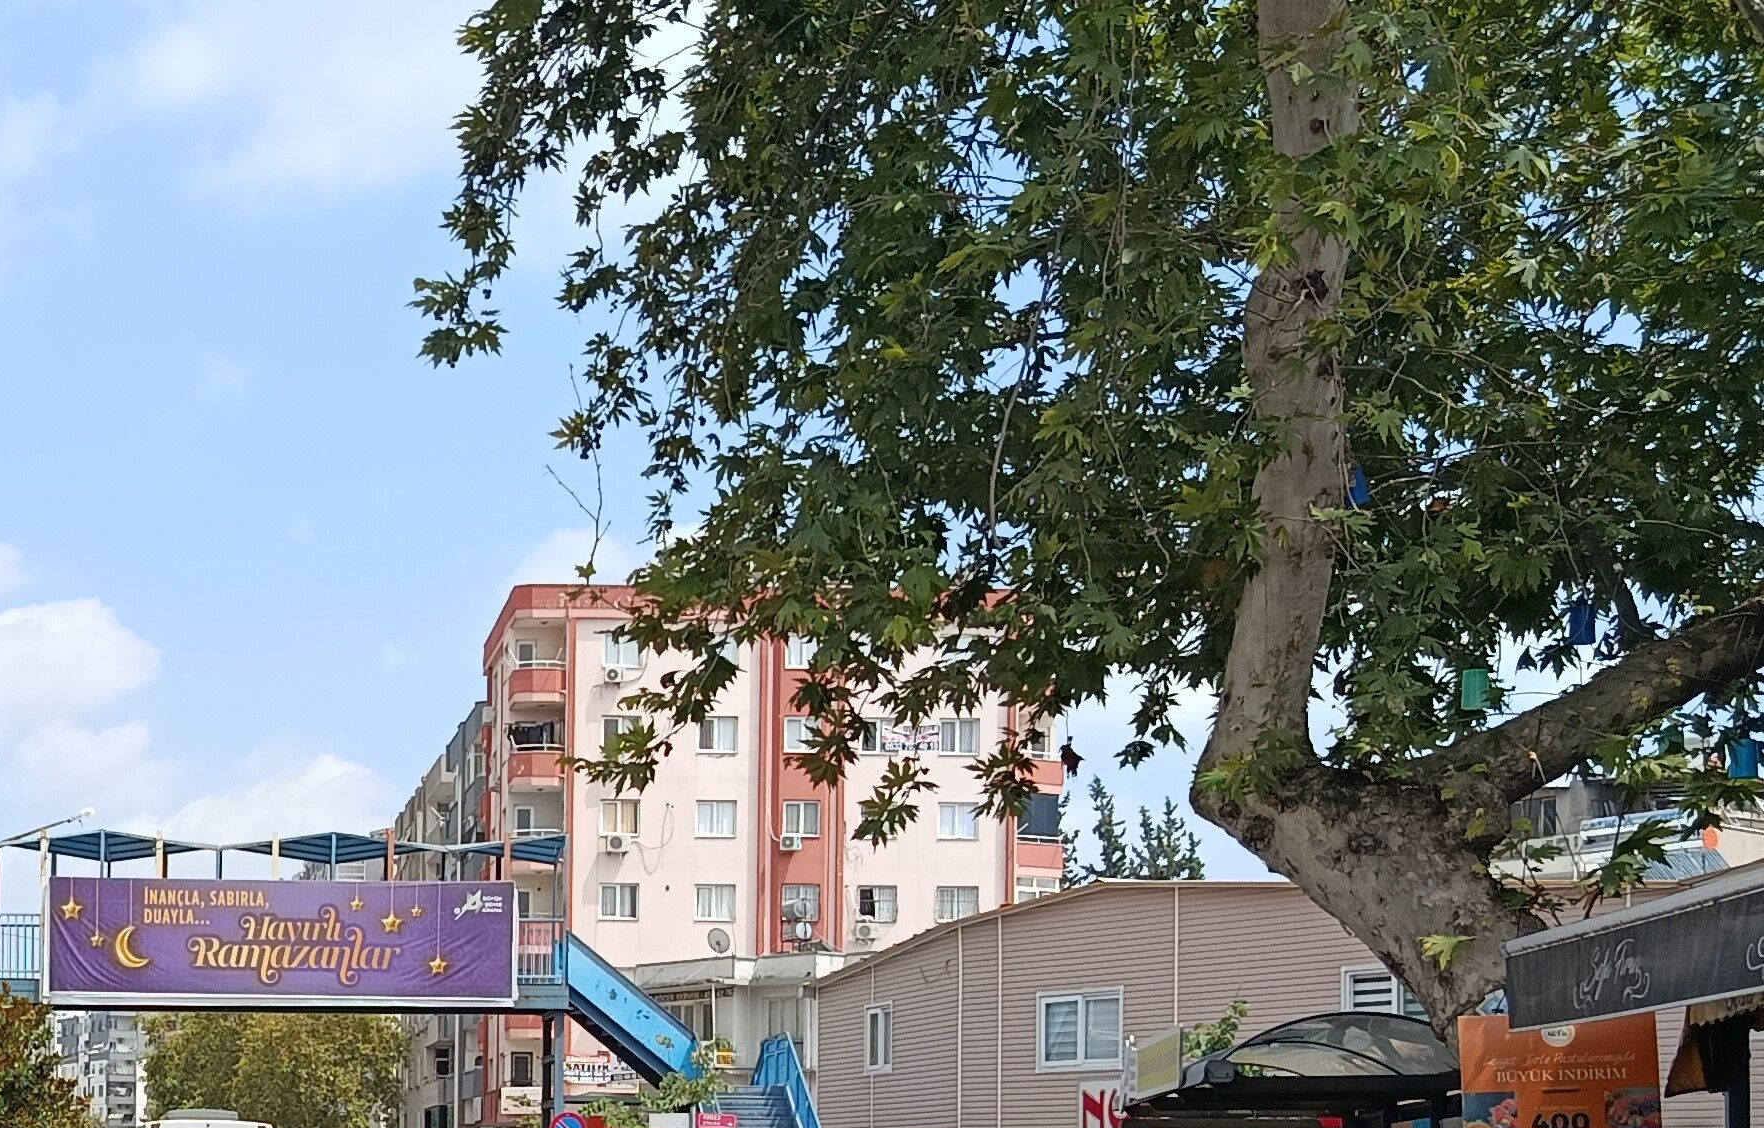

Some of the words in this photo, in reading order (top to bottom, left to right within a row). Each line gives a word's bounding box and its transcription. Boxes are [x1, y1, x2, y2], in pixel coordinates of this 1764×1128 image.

[144, 886, 205, 908] İNANÇLA,
[210, 890, 270, 909] SABIRLA,
[144, 908, 210, 925] DUAYLA...
[241, 906, 342, 943] Hayırlı
[188, 926, 401, 985] Ramazanlar
[1497, 1067, 1555, 1083] BÜYÜK
[1558, 1064, 1628, 1082] İNDİRİM
